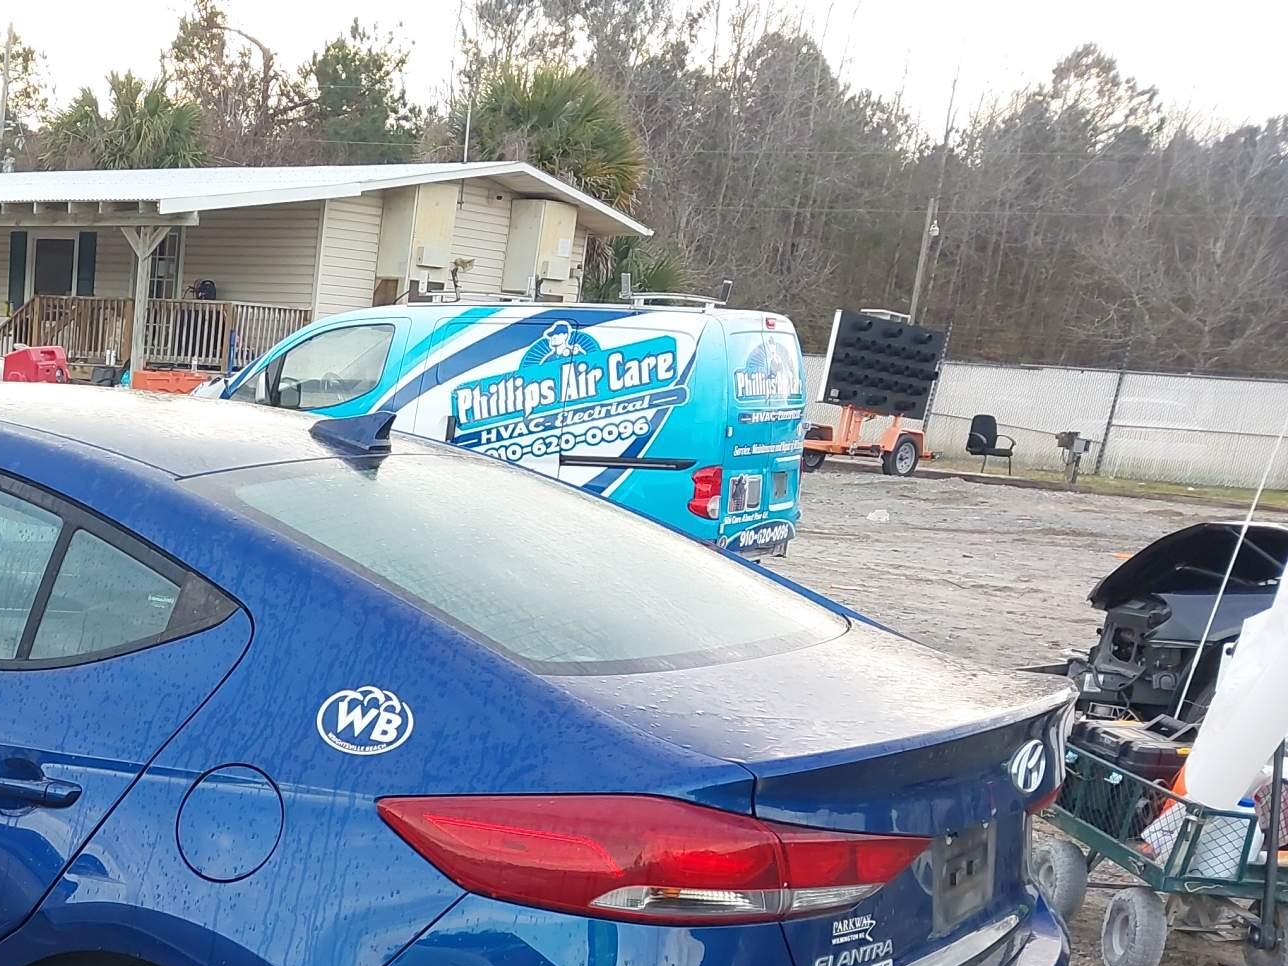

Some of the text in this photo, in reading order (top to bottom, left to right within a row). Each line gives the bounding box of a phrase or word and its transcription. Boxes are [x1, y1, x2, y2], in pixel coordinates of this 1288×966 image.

[456, 350, 675, 425] Phillips Air Care
[555, 396, 651, 426] Electrical
[337, 701, 403, 743] WB
[833, 914, 872, 934] PARKWAY
